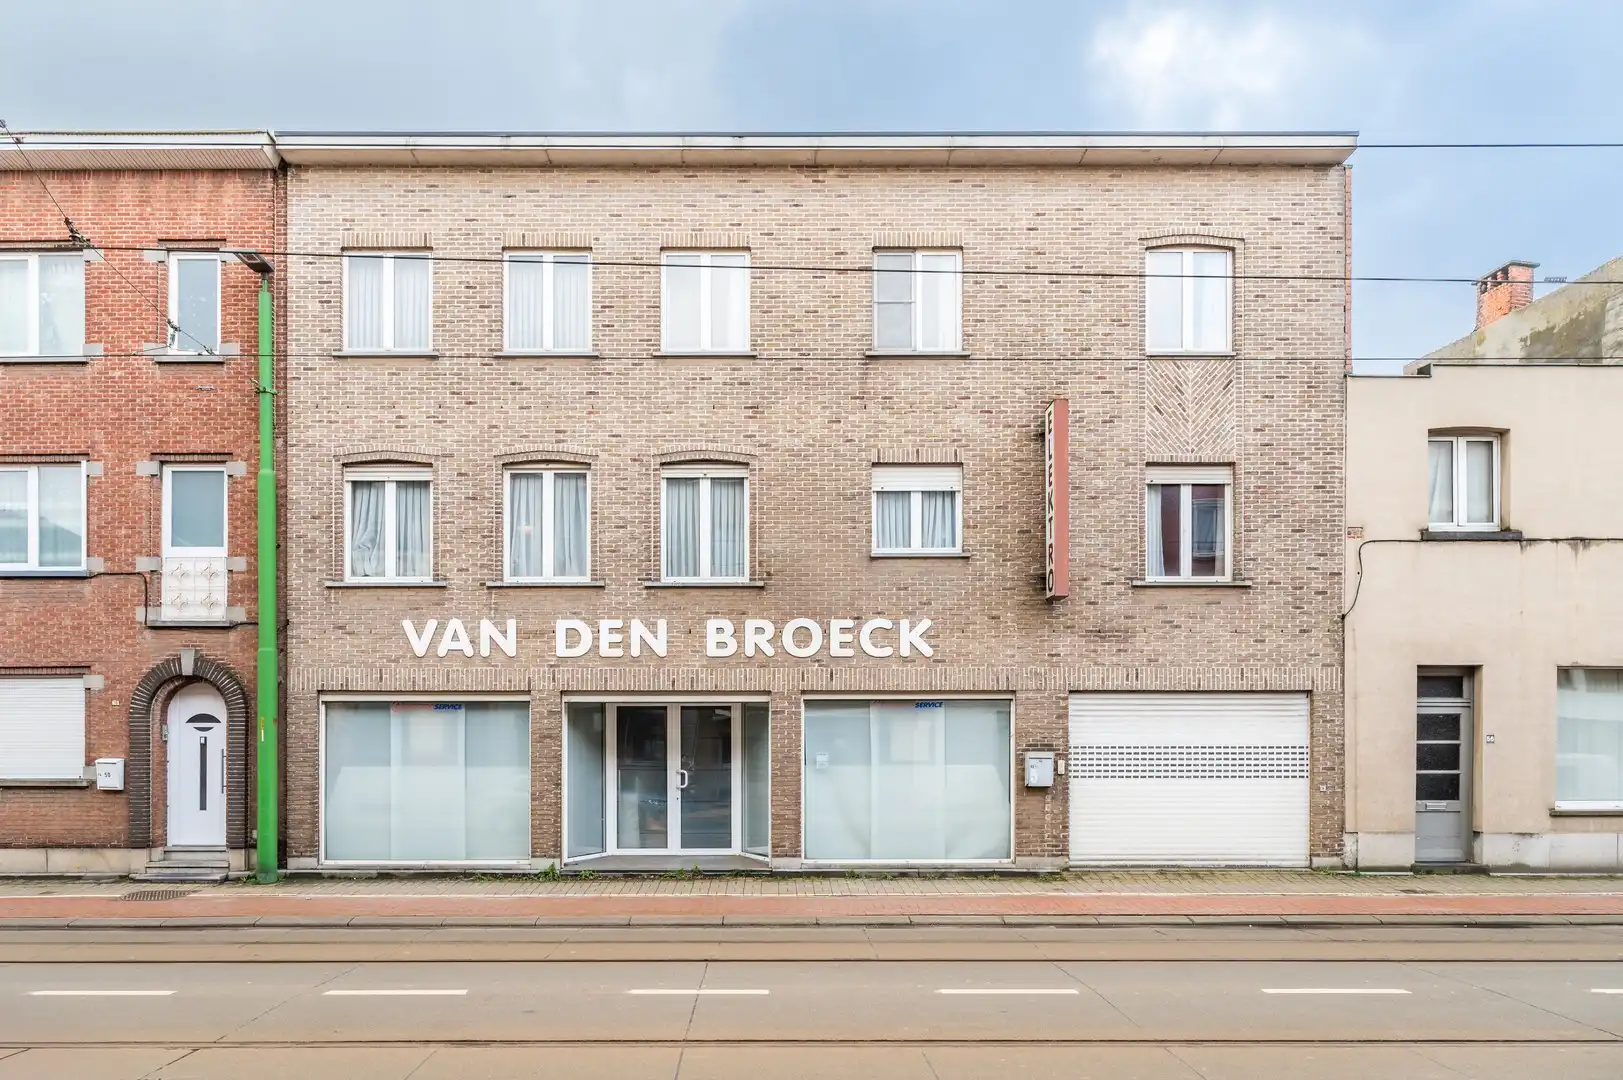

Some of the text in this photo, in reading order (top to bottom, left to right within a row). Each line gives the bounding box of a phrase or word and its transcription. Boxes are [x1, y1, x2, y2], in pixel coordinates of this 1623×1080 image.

[402, 617, 934, 658] VAN DEN BROECK
[914, 701, 944, 709] SERVICE
